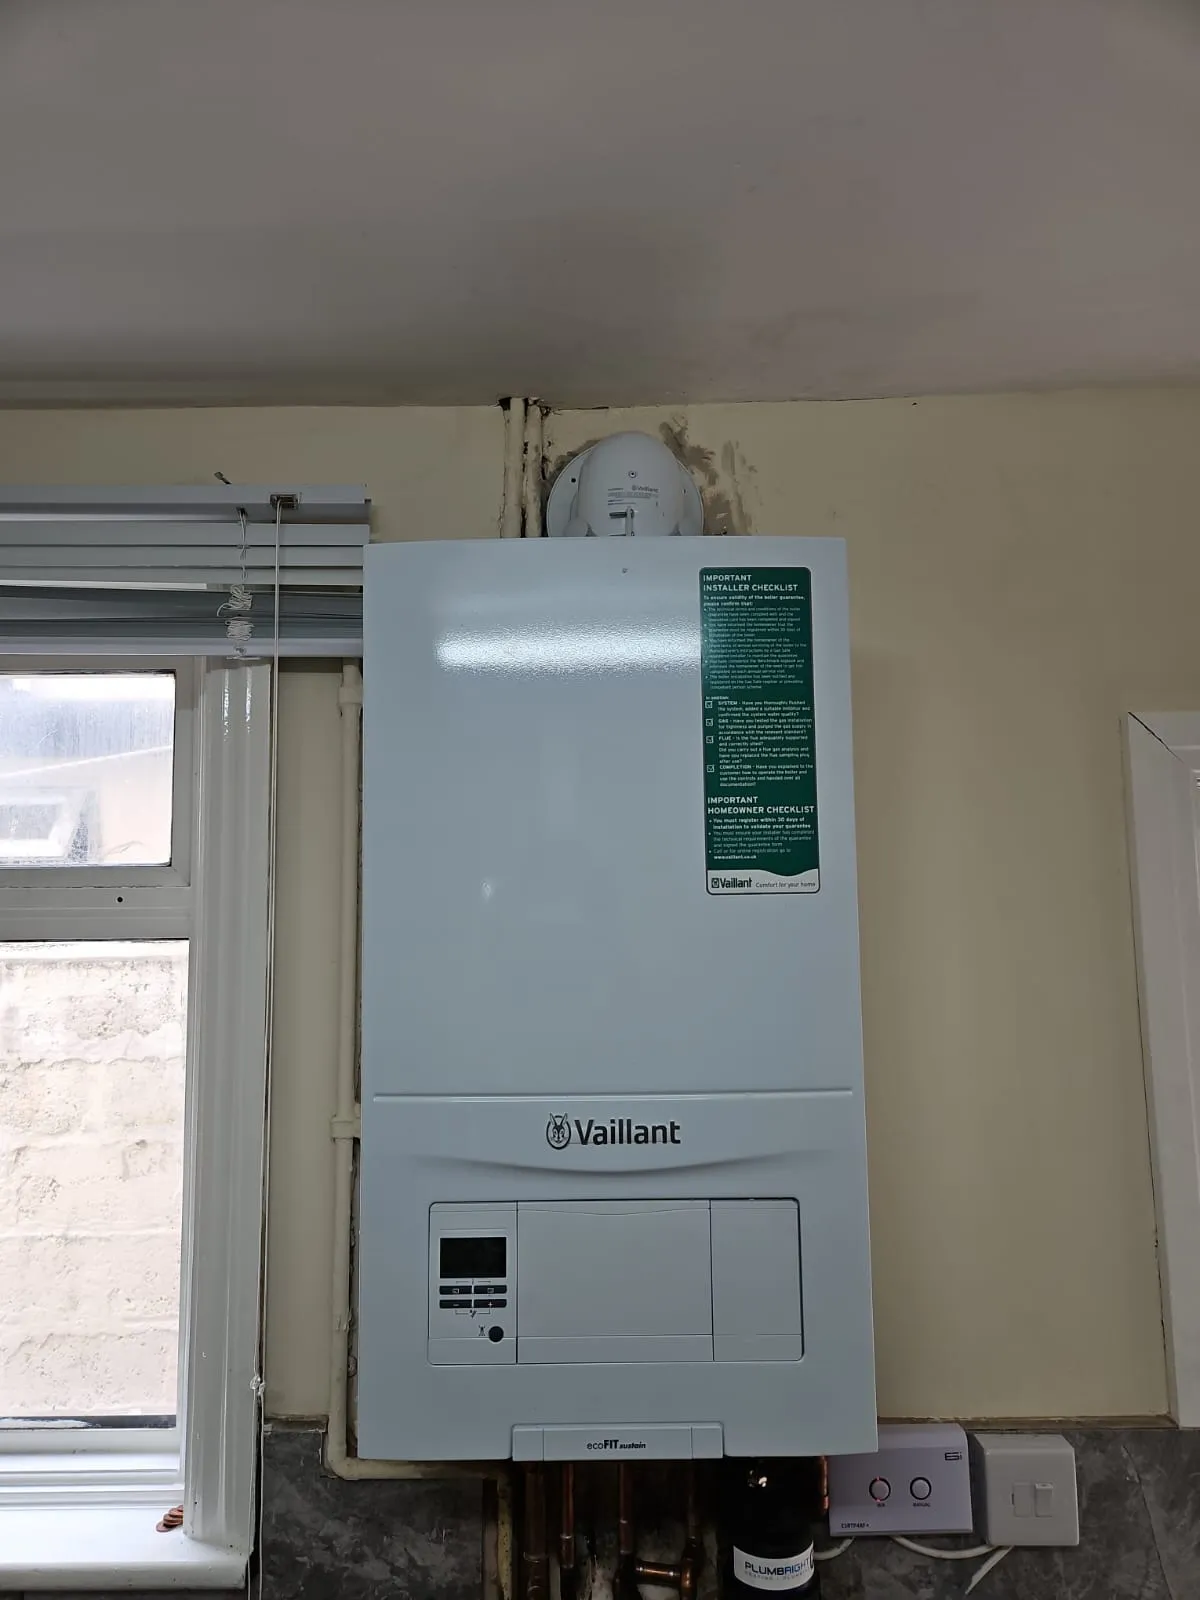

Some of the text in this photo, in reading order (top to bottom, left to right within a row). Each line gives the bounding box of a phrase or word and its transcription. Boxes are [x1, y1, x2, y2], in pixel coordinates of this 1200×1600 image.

[708, 796, 758, 804] IMPORTANT
[708, 806, 814, 814] HOMEOWNER CHECKLIST
[720, 877, 752, 889] Vaillant
[574, 1119, 681, 1145] Vaillant
[586, 1439, 620, 1450] ecoFIT
[744, 1558, 809, 1576] PLUMBRIGHT
